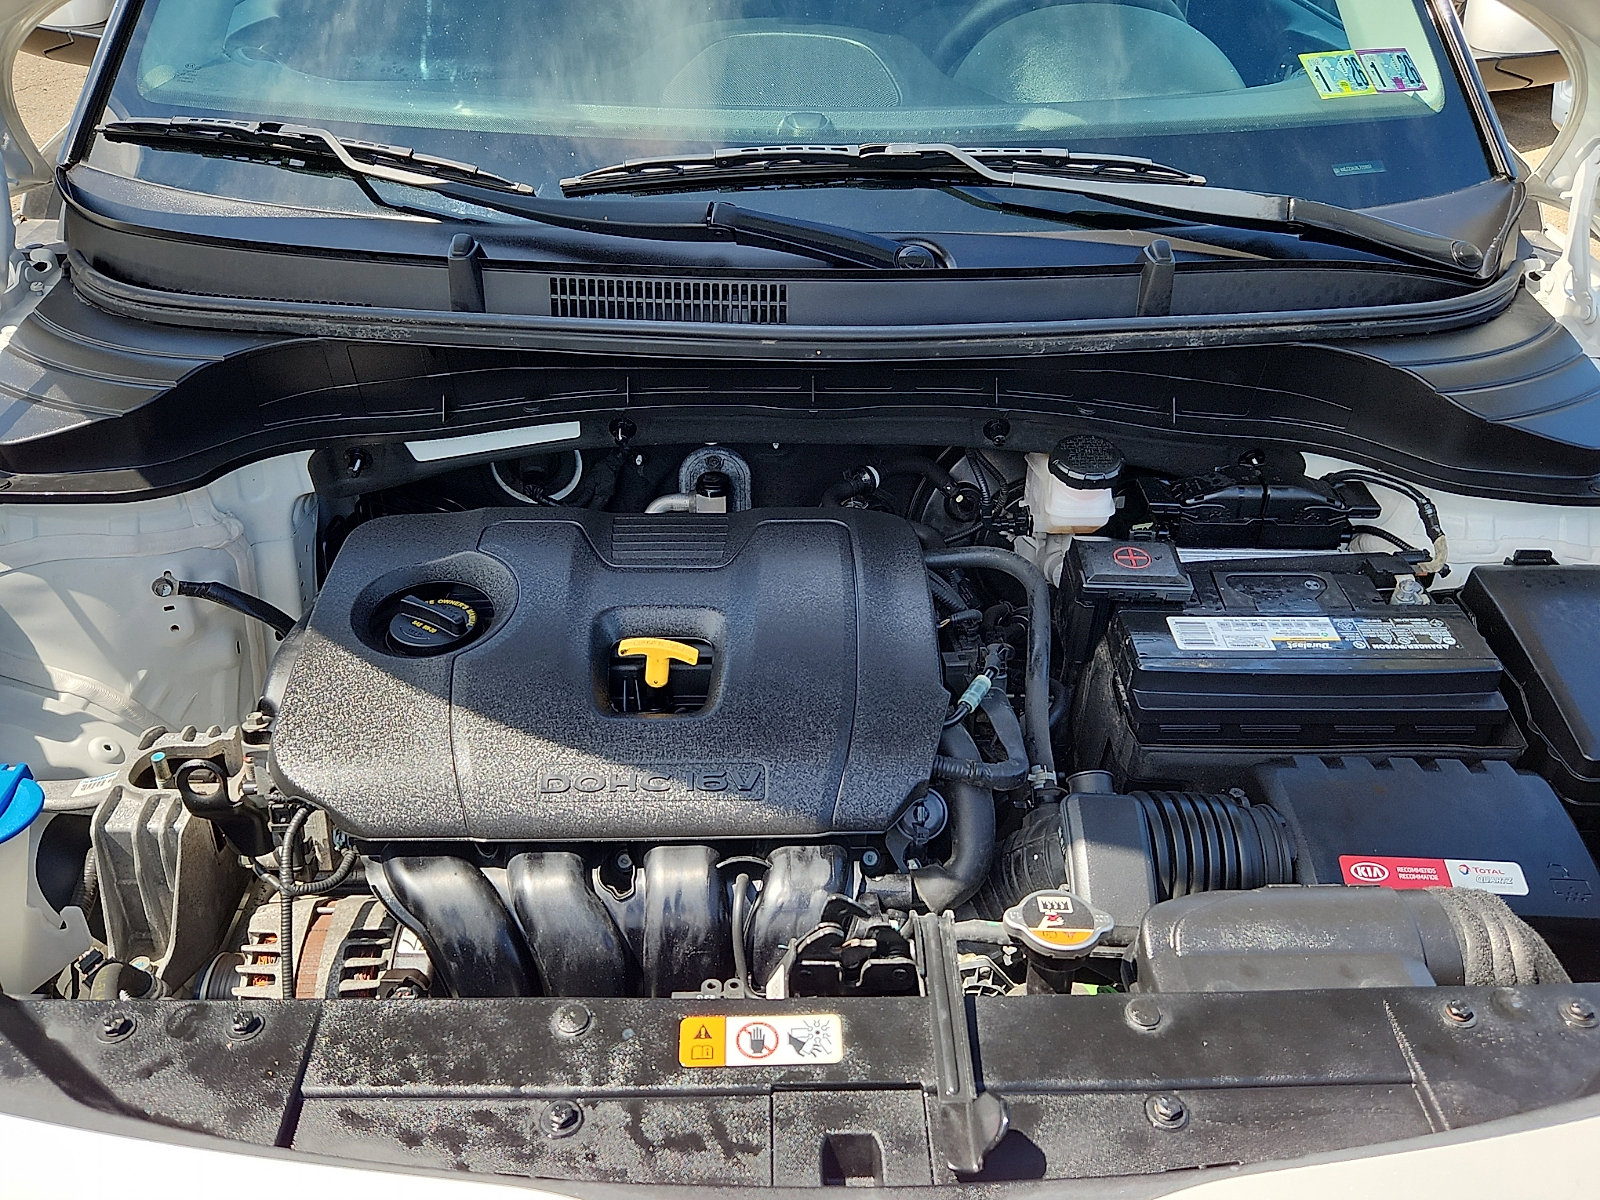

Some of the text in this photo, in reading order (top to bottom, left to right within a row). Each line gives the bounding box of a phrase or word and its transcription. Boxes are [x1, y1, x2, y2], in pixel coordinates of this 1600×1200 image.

[1314, 56, 1370, 93] 1 26
[1370, 54, 1422, 88] 1 26
[1286, 640, 1333, 650] Duralast
[540, 770, 763, 794] DOHC 16V
[1396, 866, 1437, 874] RECOMMENDS
[1398, 873, 1440, 881] RECOMMANDE
[1475, 875, 1514, 885] QUARTZ
